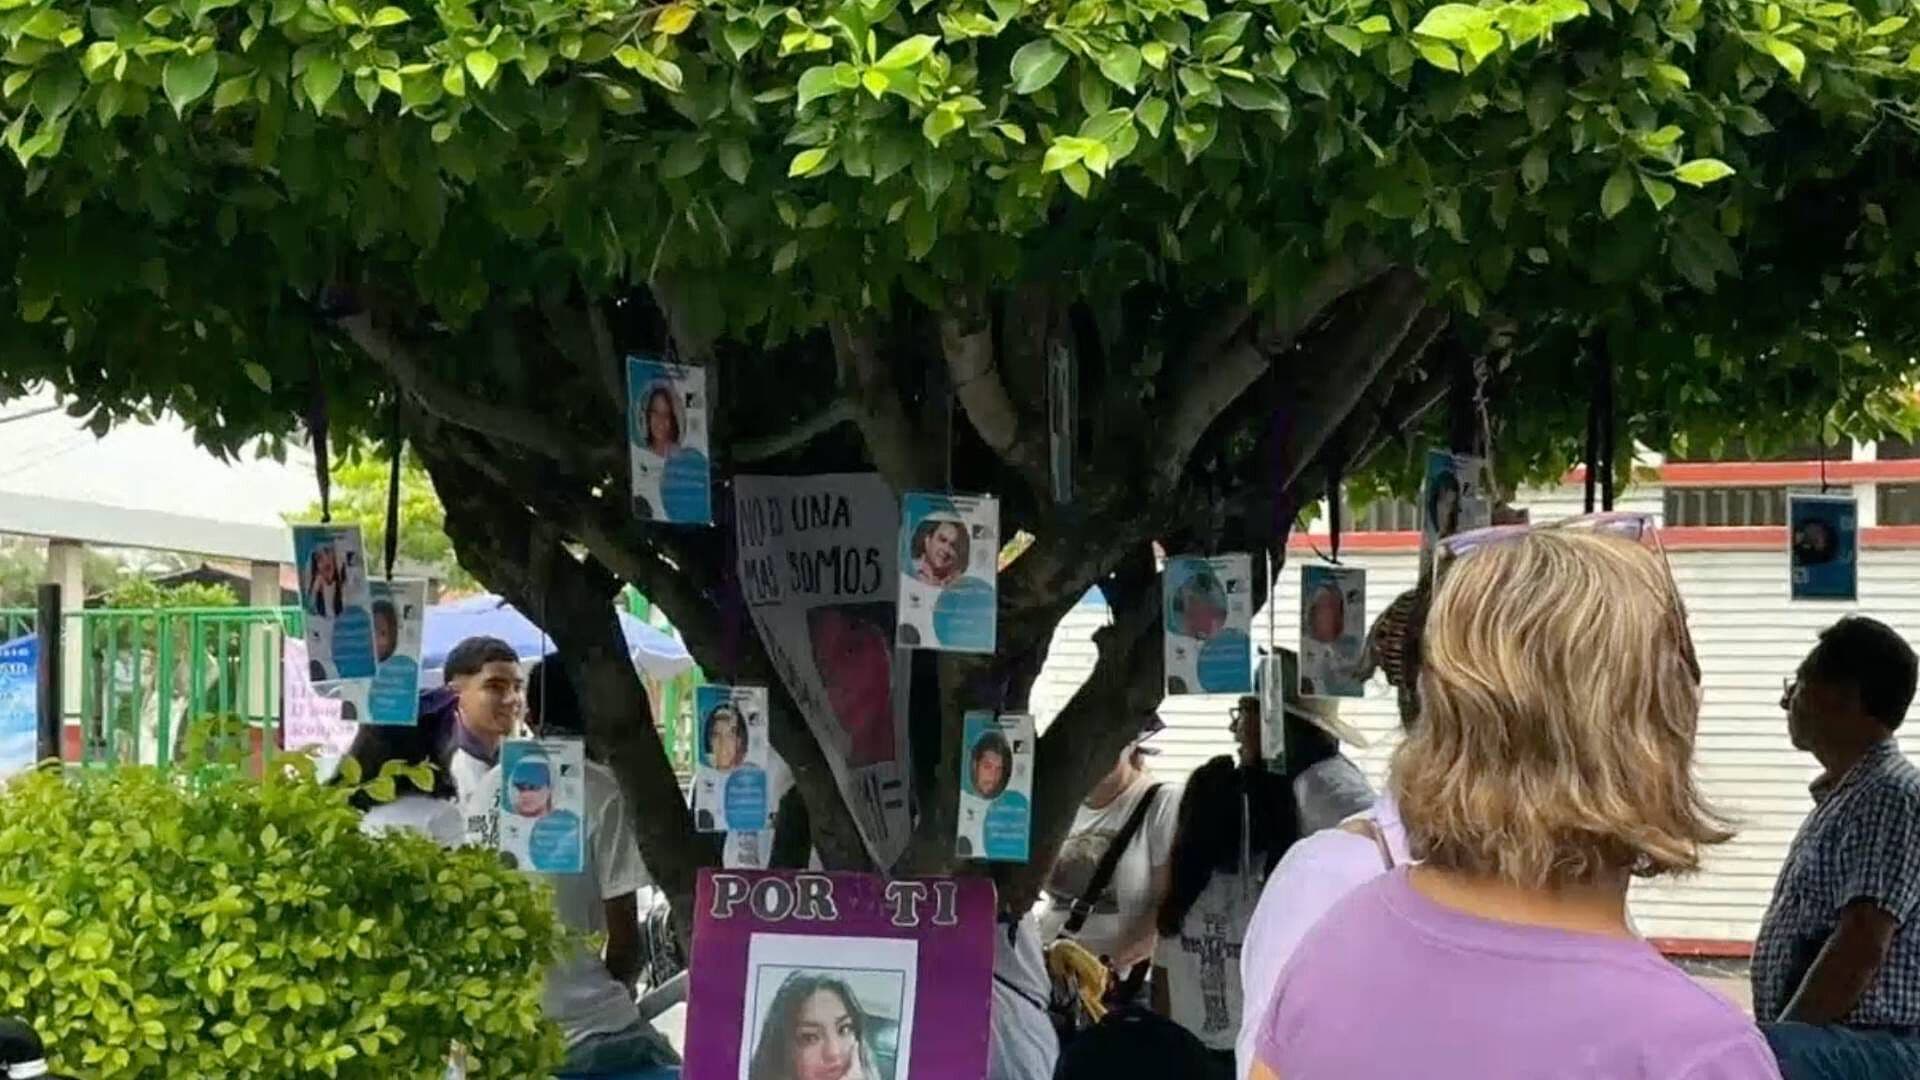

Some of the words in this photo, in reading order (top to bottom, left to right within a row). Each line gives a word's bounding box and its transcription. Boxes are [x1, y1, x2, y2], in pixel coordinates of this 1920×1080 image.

[790, 493, 850, 532] UNA
[787, 545, 882, 595] SOMOS
[710, 873, 839, 922] POR
[885, 879, 958, 927] TI
